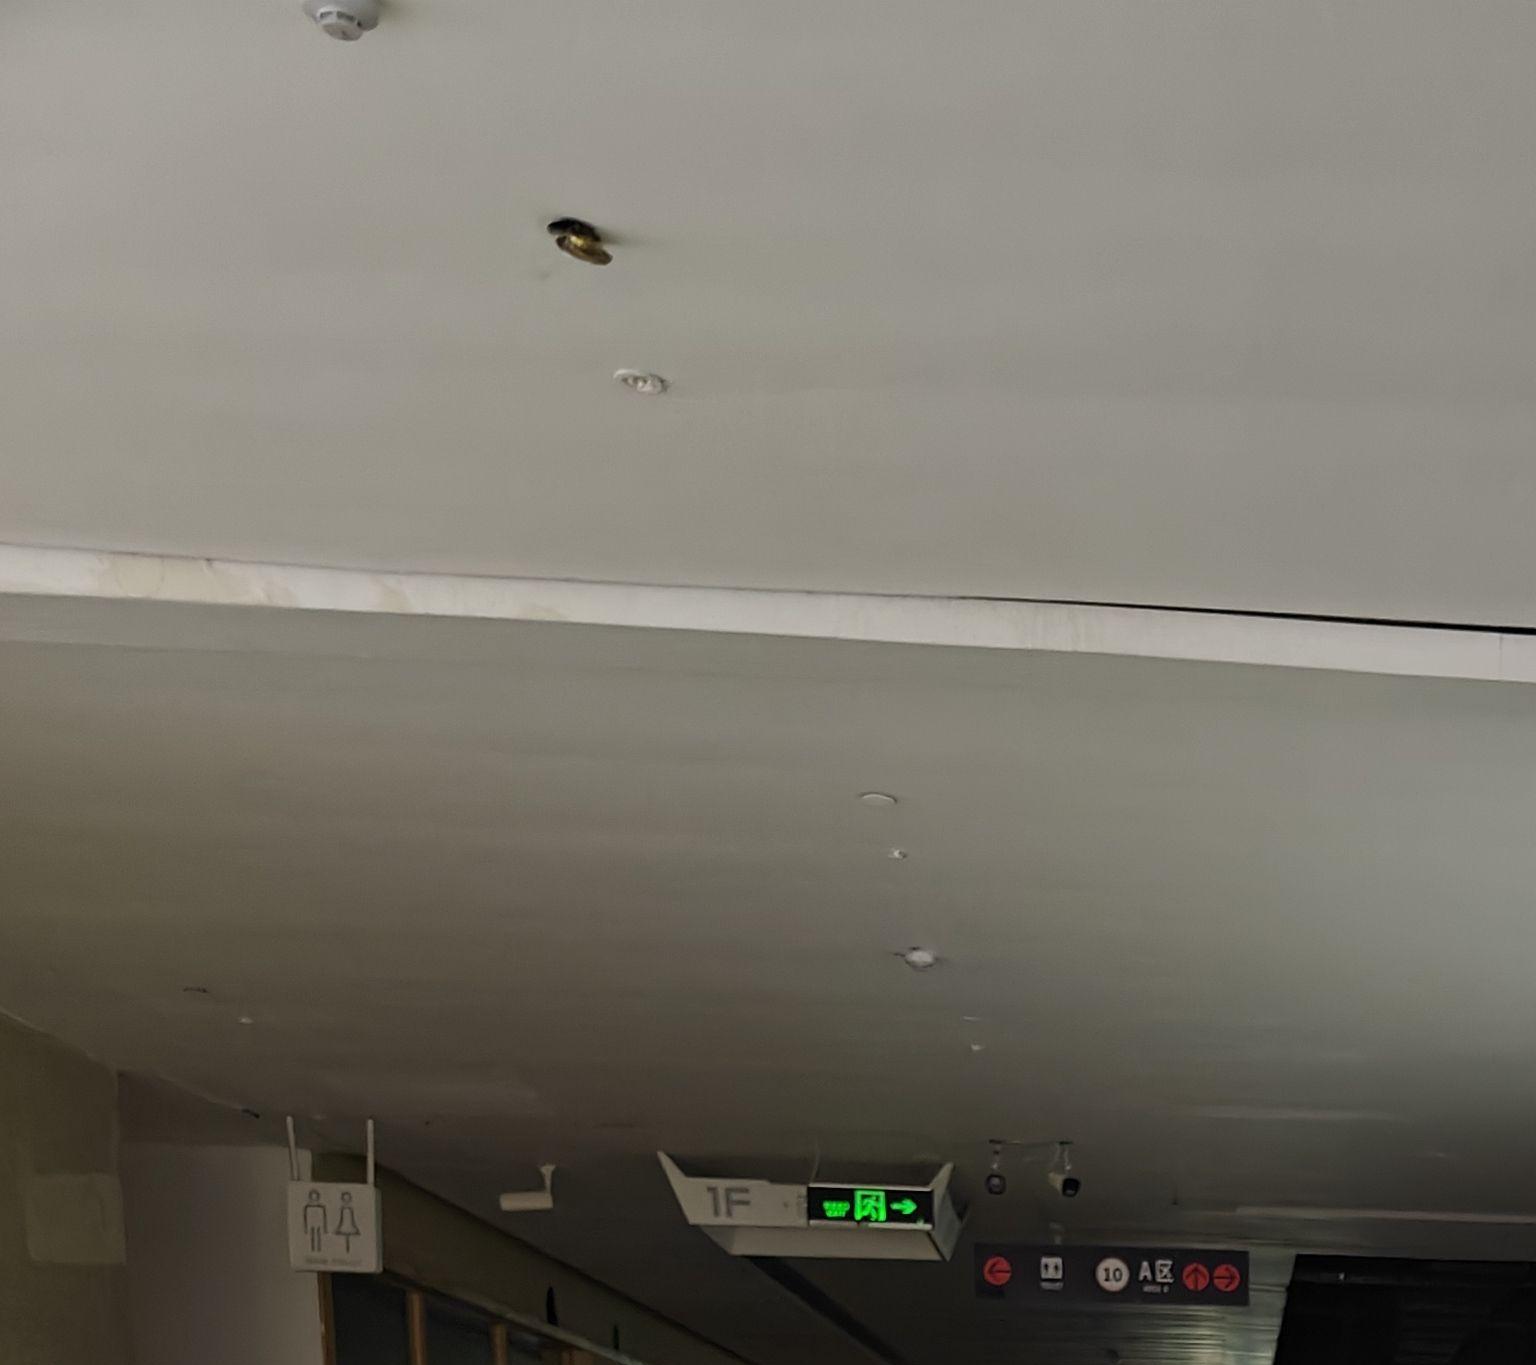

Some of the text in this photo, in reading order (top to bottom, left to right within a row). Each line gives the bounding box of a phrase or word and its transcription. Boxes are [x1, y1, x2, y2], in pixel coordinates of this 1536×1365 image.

[706, 1186, 750, 1218] 1F
[1103, 1267, 1123, 1283] 10
[1138, 1259, 1175, 1284] A区
